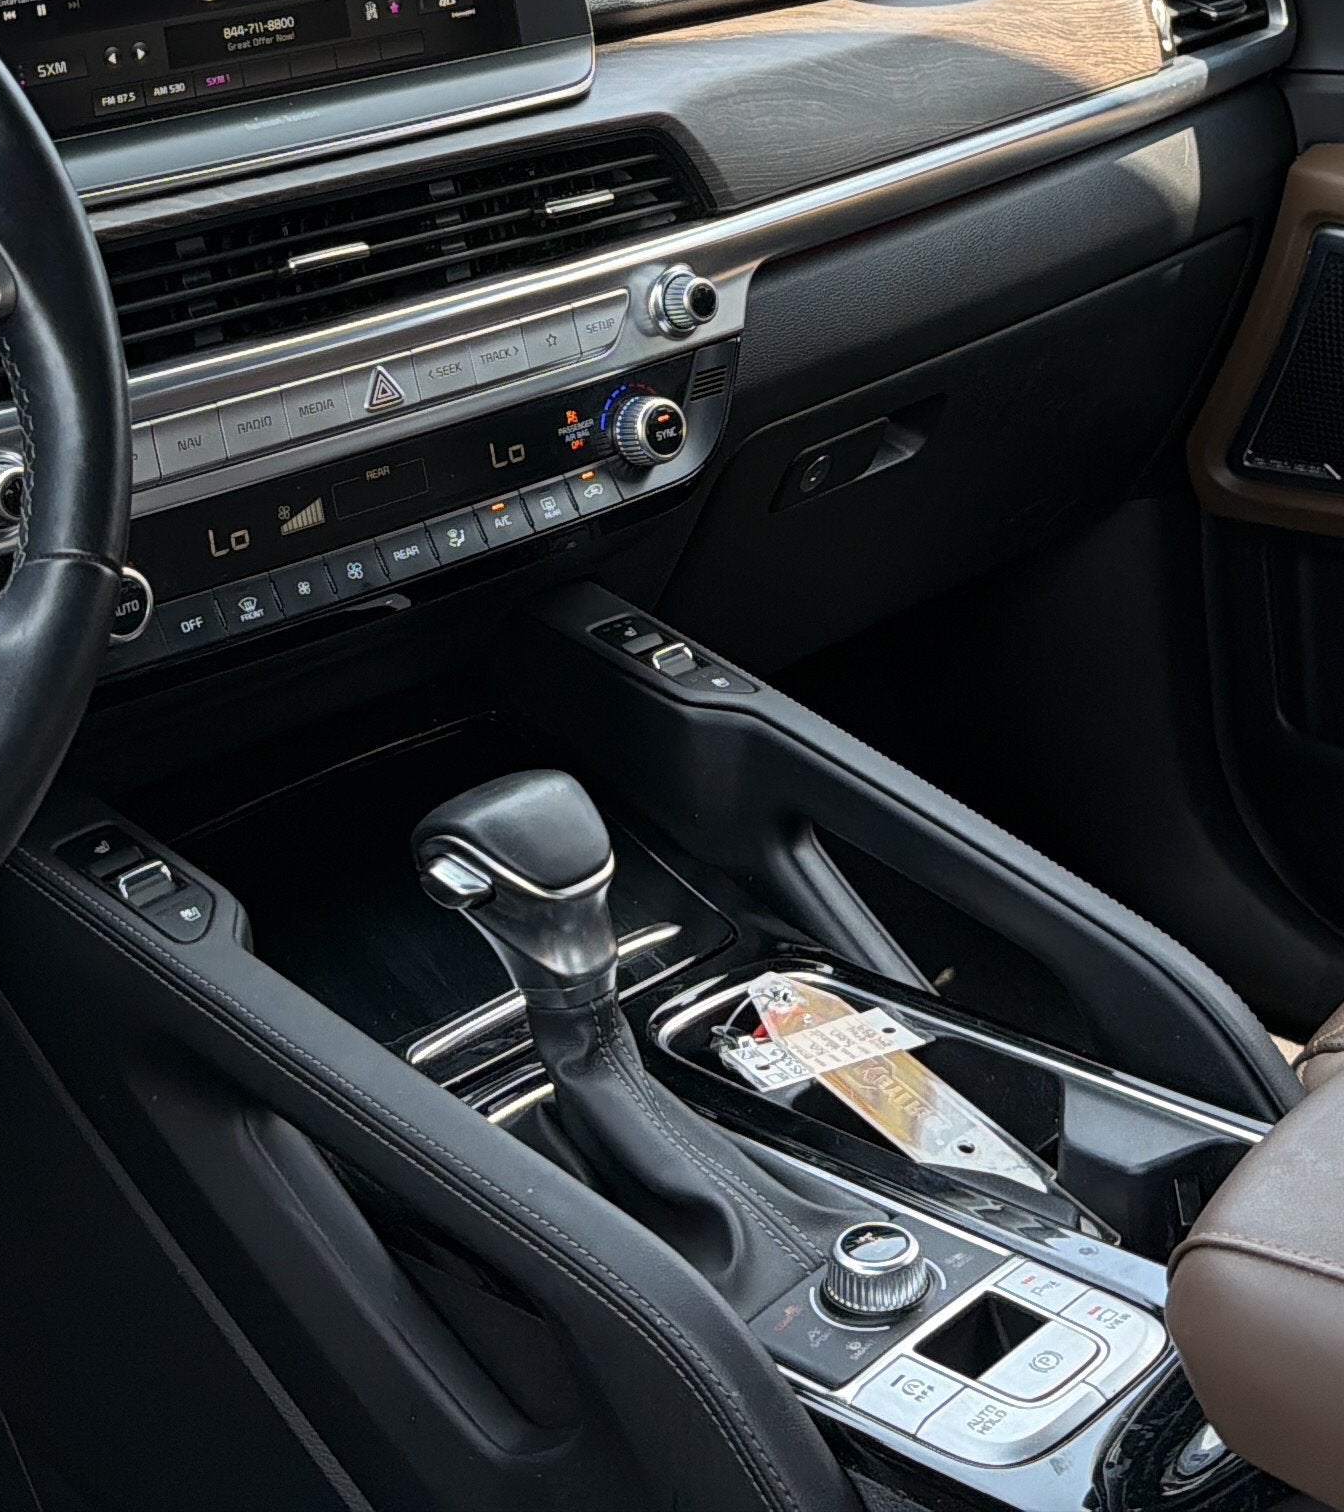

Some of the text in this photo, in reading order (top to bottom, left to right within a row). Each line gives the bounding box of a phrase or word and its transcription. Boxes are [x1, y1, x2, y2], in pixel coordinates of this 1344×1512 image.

[223, 16, 295, 40] 844-711-8800
[227, 37, 250, 52] Great
[252, 34, 274, 48] Offer
[37, 60, 68, 79] SXM
[153, 81, 186, 97] AM 530
[101, 91, 136, 107] FM 87.5
[585, 317, 616, 335] SETUP
[480, 348, 512, 365] TRACK
[435, 362, 463, 377] SEEK
[298, 398, 336, 418] MEDIA
[237, 415, 273, 434] RADIO
[656, 426, 677, 442] SYNC
[177, 435, 202, 452] NAV
[365, 465, 391, 481] REAR
[494, 514, 513, 529] A/C
[393, 545, 420, 562] REAR
[240, 607, 265, 623] FRONT
[180, 616, 204, 634] OFF
[967, 1404, 998, 1430] AUTO
[972, 1409, 1008, 1435] HOLD
